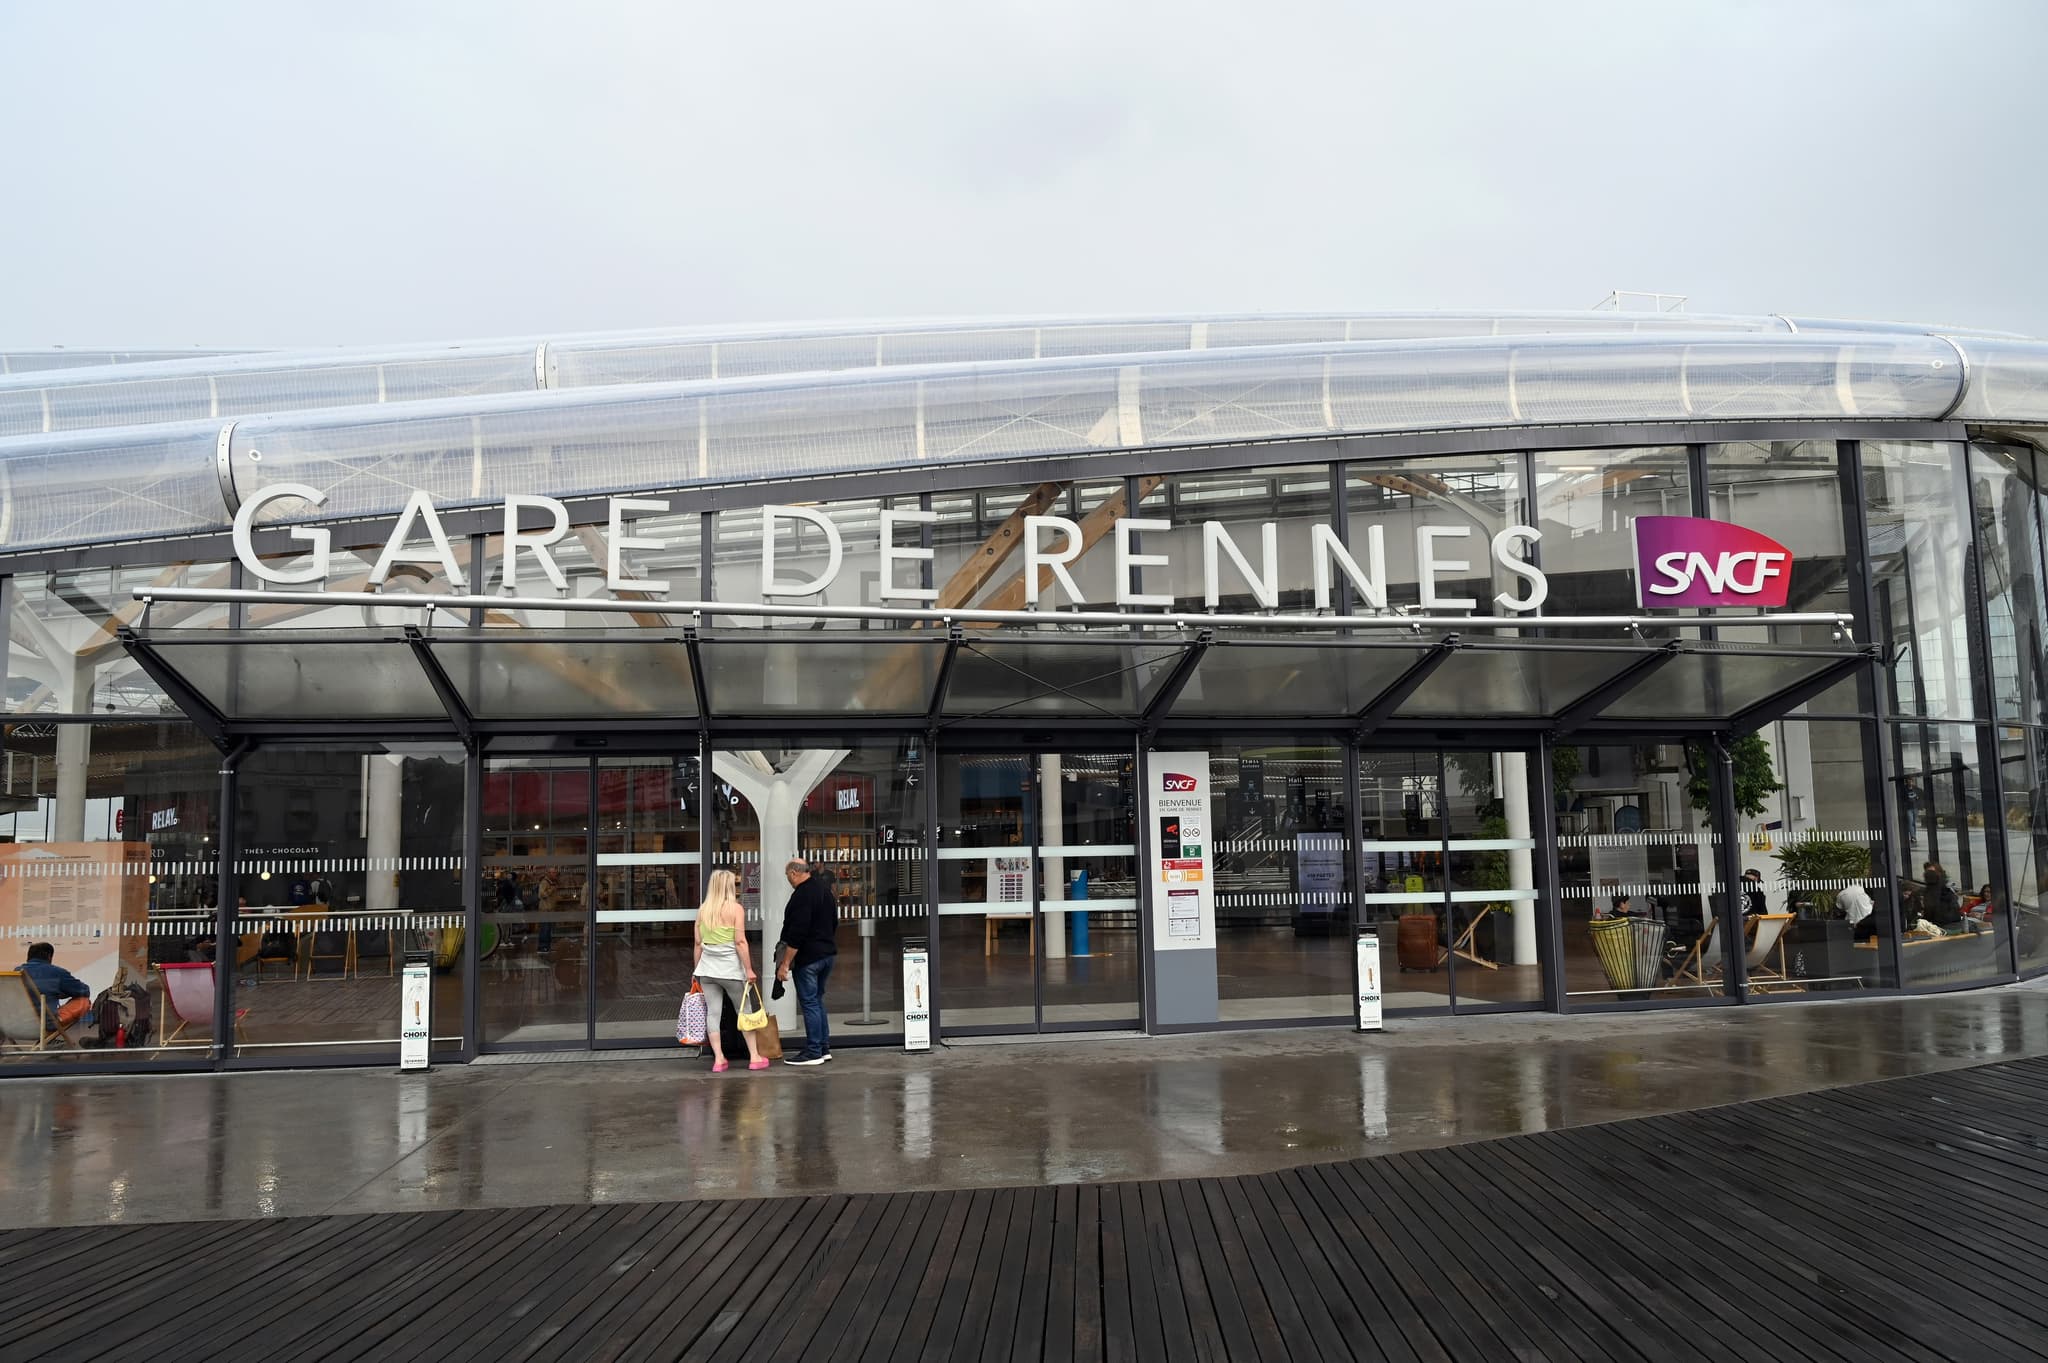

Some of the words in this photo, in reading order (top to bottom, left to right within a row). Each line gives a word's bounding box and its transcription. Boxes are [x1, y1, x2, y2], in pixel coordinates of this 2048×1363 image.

[233, 483, 670, 593] GARE
[762, 504, 938, 601] DE
[1023, 515, 1548, 612] RENNES
[1647, 550, 1783, 596] SNCF
[1165, 780, 1194, 790] SNCF
[839, 788, 858, 810] RELAY
[152, 807, 176, 830] RELAY
